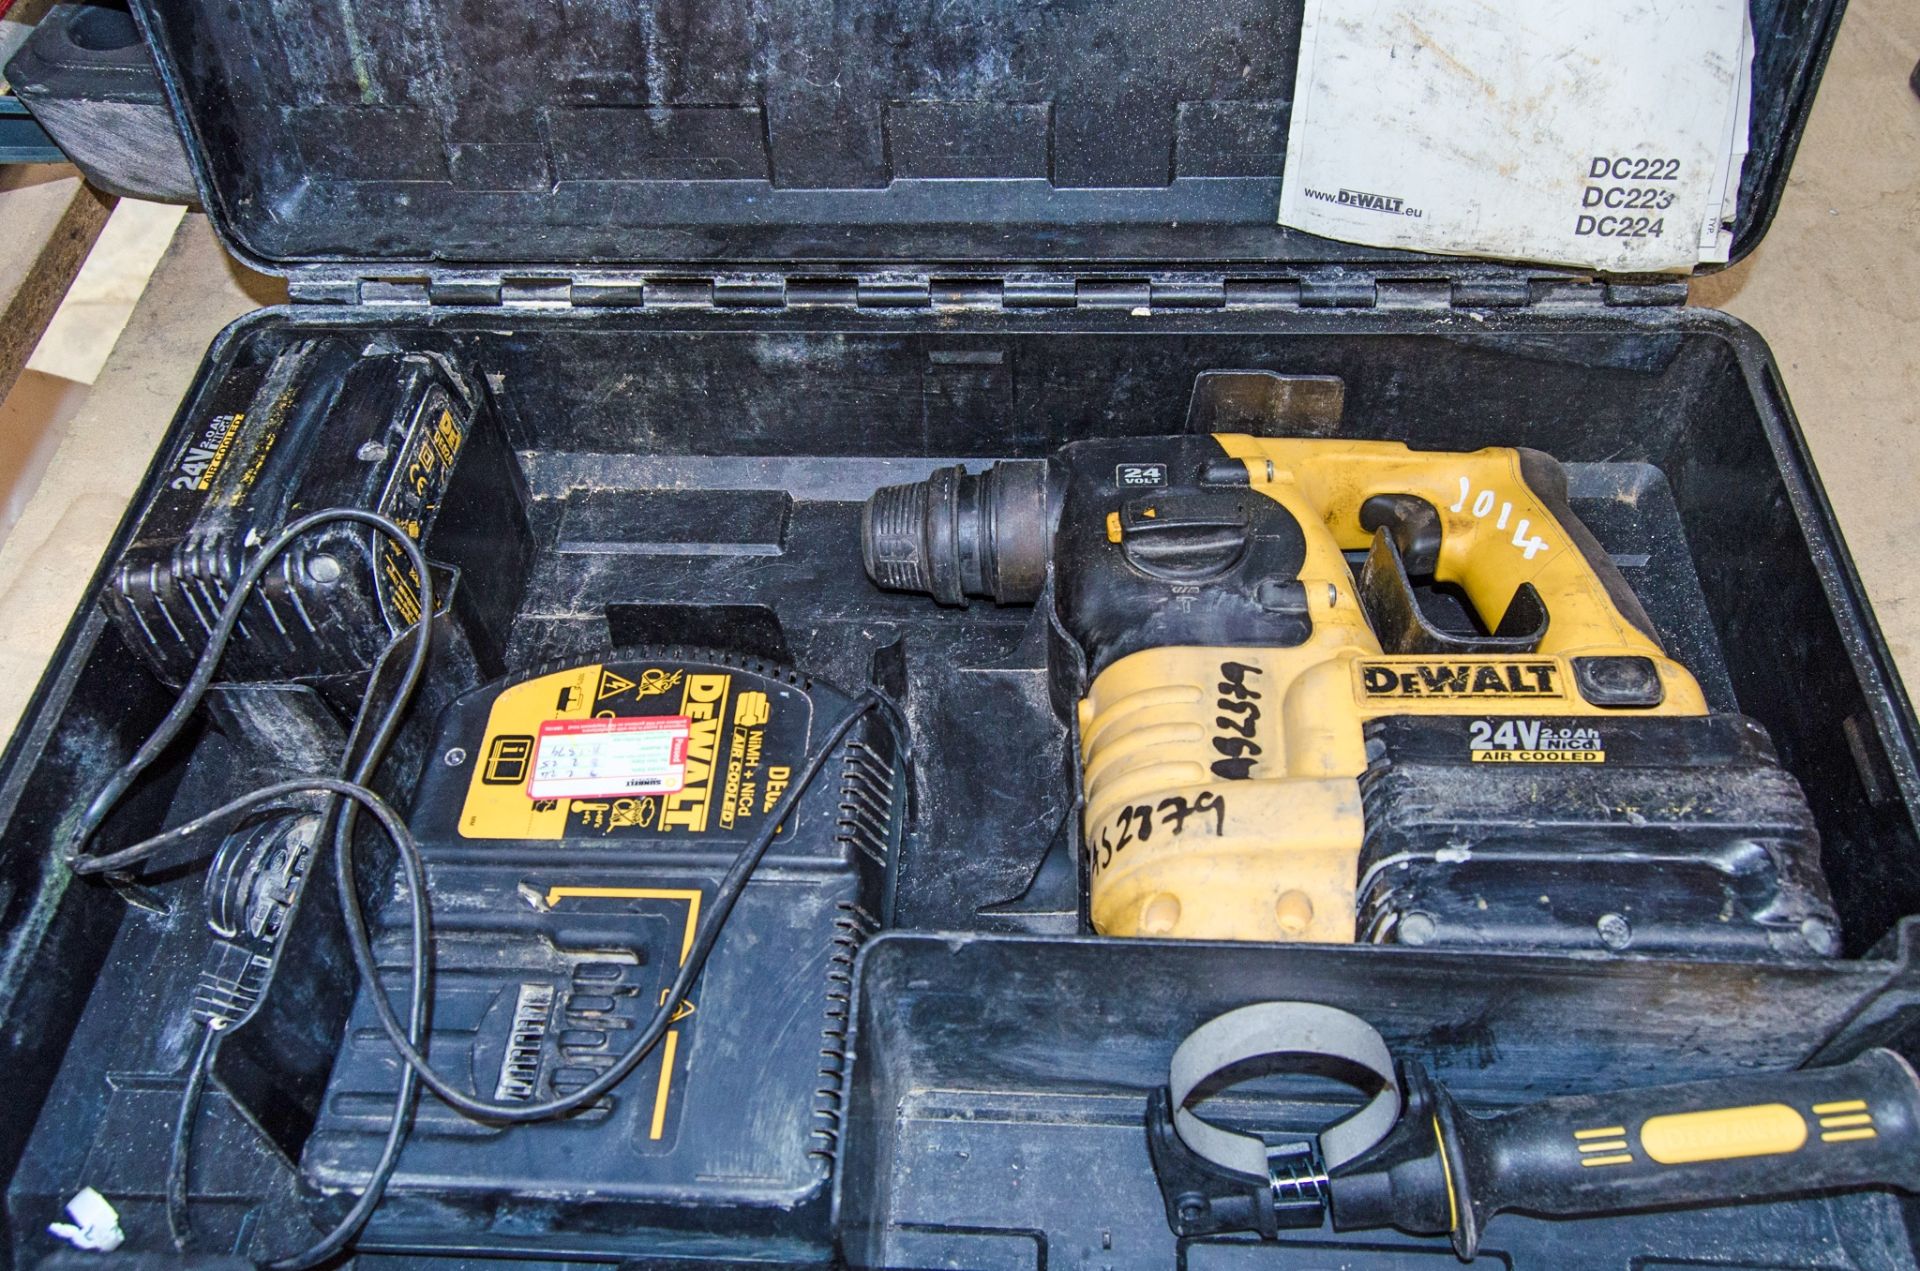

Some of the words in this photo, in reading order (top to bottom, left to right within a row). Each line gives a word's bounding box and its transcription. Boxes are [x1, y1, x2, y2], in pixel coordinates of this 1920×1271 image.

[1588, 156, 1681, 181] DC222
[1582, 185, 1676, 210] DC223
[1574, 214, 1665, 238] DC224
[171, 446, 216, 491] 24V
[1124, 467, 1162, 478] 24
[1124, 477, 1161, 485] VOLT
[1363, 665, 1557, 694] DEWALT
[731, 732, 746, 758] AIR
[1469, 719, 1541, 751] 24V
[744, 730, 763, 767] NiMH
[1481, 751, 1513, 761] AIR
[1516, 751, 1597, 761] COOLED
[721, 761, 743, 823] COOLED
[737, 782, 757, 817] NiCd
